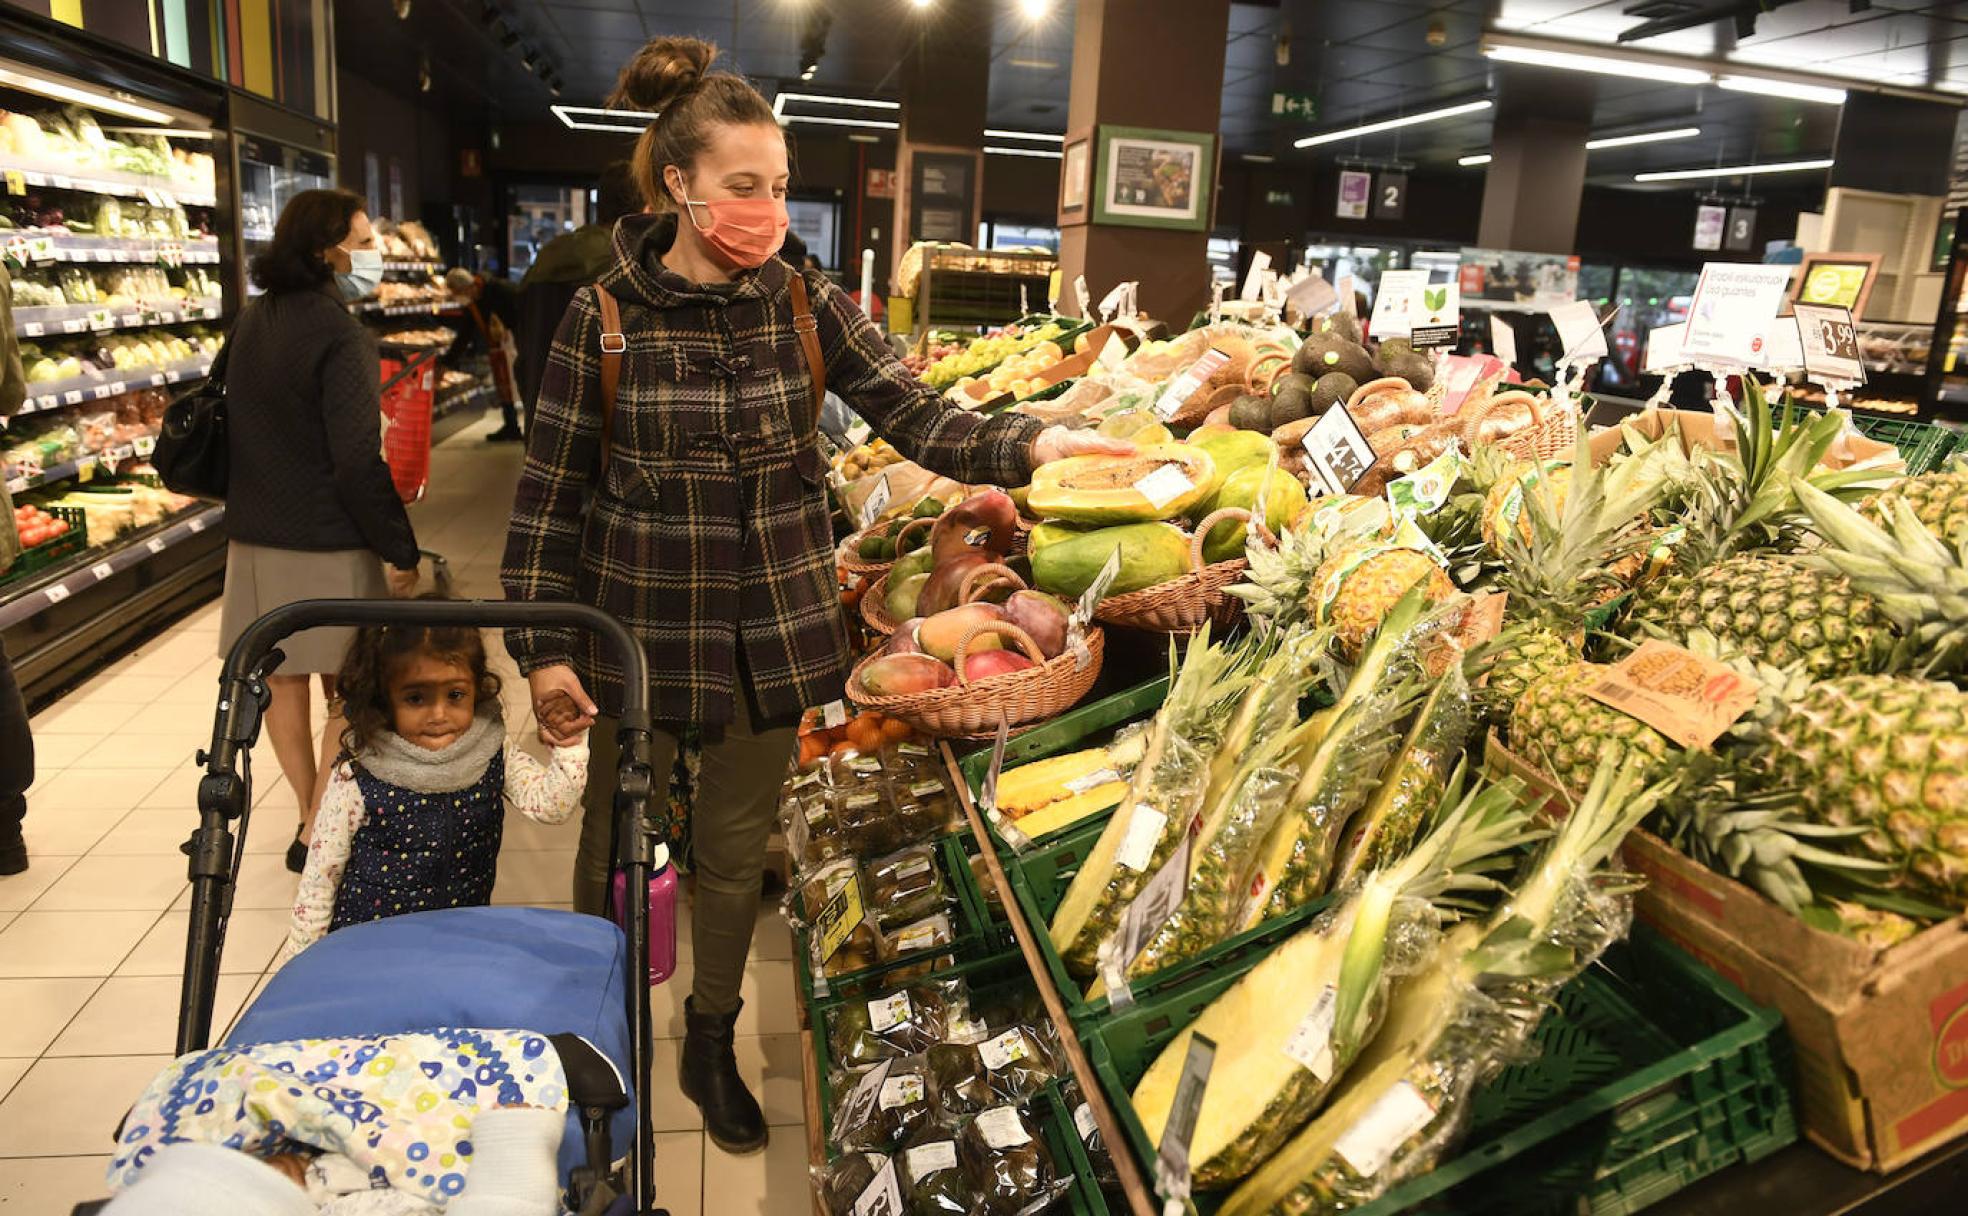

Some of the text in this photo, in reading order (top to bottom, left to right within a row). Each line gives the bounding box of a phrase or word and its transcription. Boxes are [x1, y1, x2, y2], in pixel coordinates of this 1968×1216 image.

[1384, 186, 1399, 207] 2
[1735, 219, 1748, 240] 3
[1823, 322, 1853, 354] 3,99
